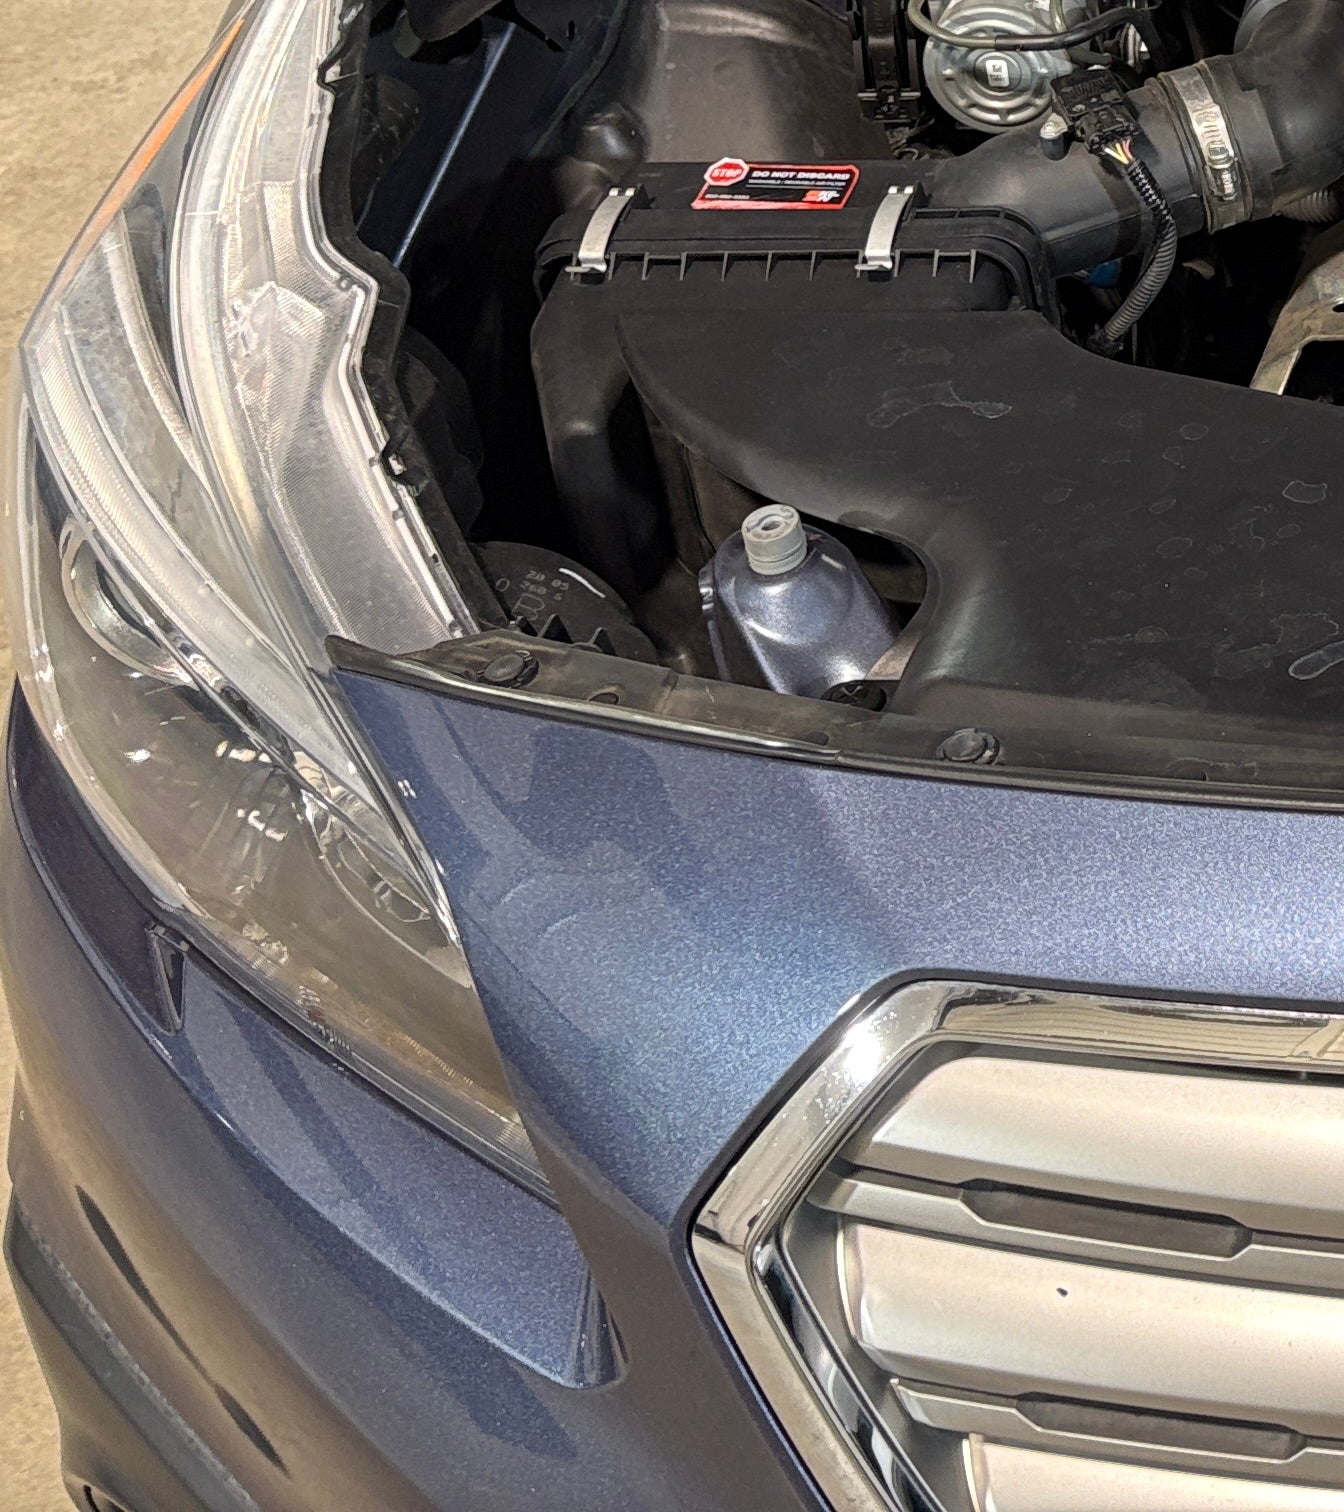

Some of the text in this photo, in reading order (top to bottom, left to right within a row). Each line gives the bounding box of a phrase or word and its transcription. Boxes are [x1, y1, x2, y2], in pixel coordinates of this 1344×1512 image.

[711, 167, 742, 178] STOP
[752, 170, 851, 180] DO NOT DISCARD
